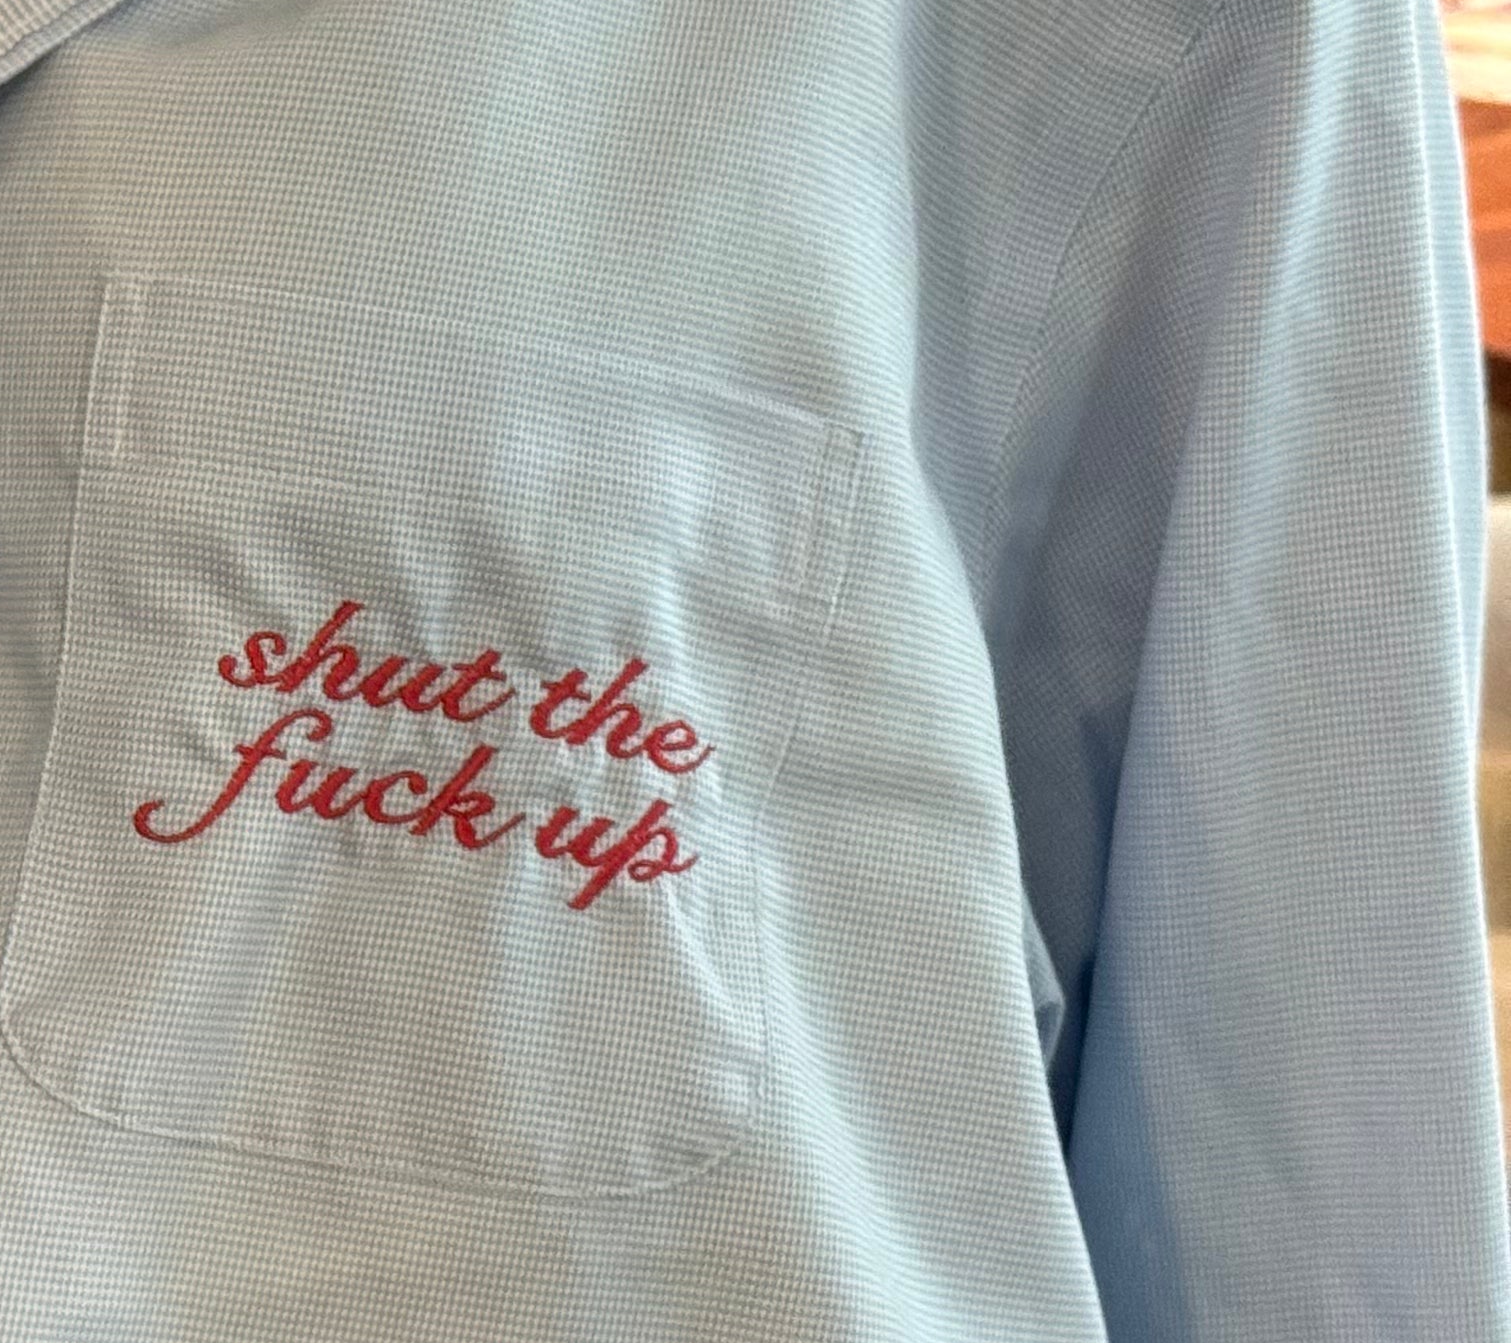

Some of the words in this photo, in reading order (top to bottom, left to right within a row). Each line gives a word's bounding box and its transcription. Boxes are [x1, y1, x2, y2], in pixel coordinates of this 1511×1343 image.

[217, 600, 516, 723] shut
[529, 658, 714, 774] the
[133, 708, 525, 850] fuck
[535, 800, 698, 910] up
